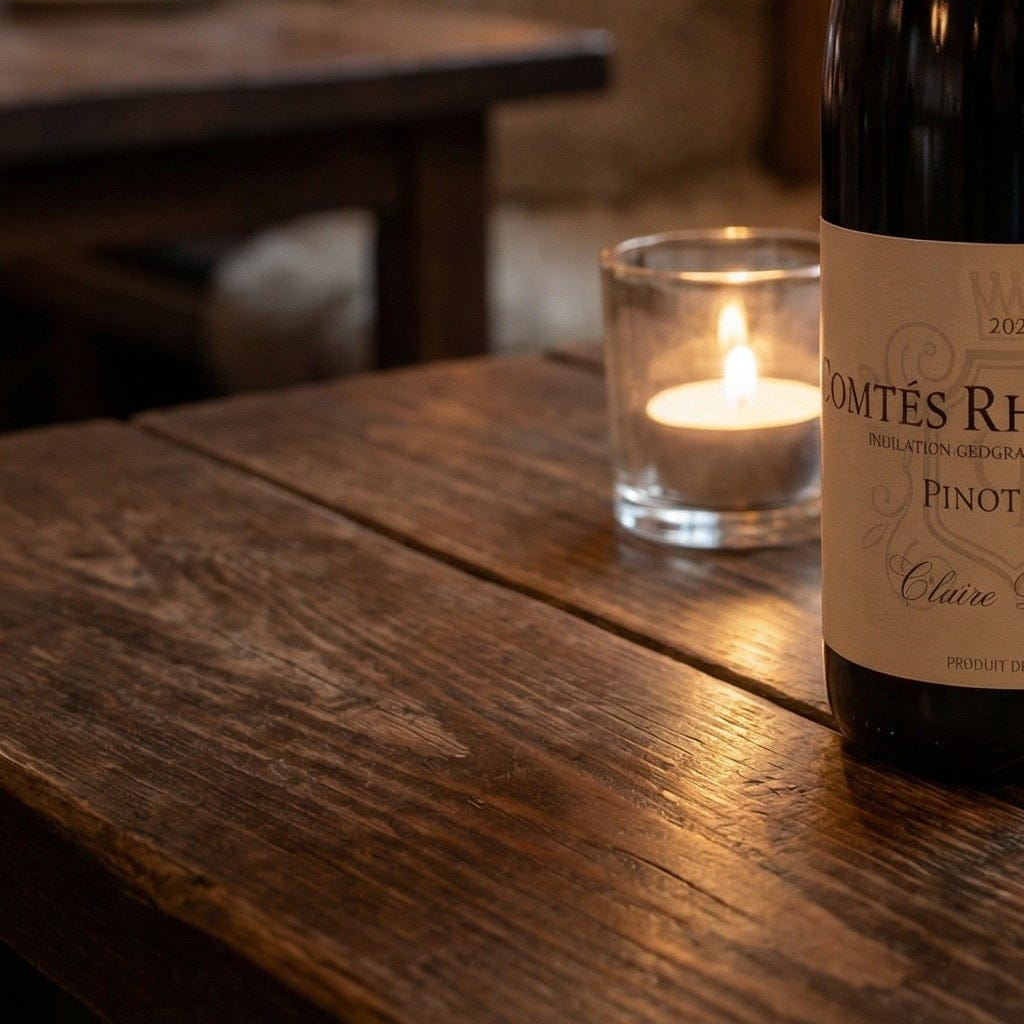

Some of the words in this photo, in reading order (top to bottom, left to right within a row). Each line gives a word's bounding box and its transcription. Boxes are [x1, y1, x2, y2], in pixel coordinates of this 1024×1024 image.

[923, 478, 1020, 513] PINOT
[888, 554, 998, 608] Claire
[947, 656, 1009, 673] PRODUIT
